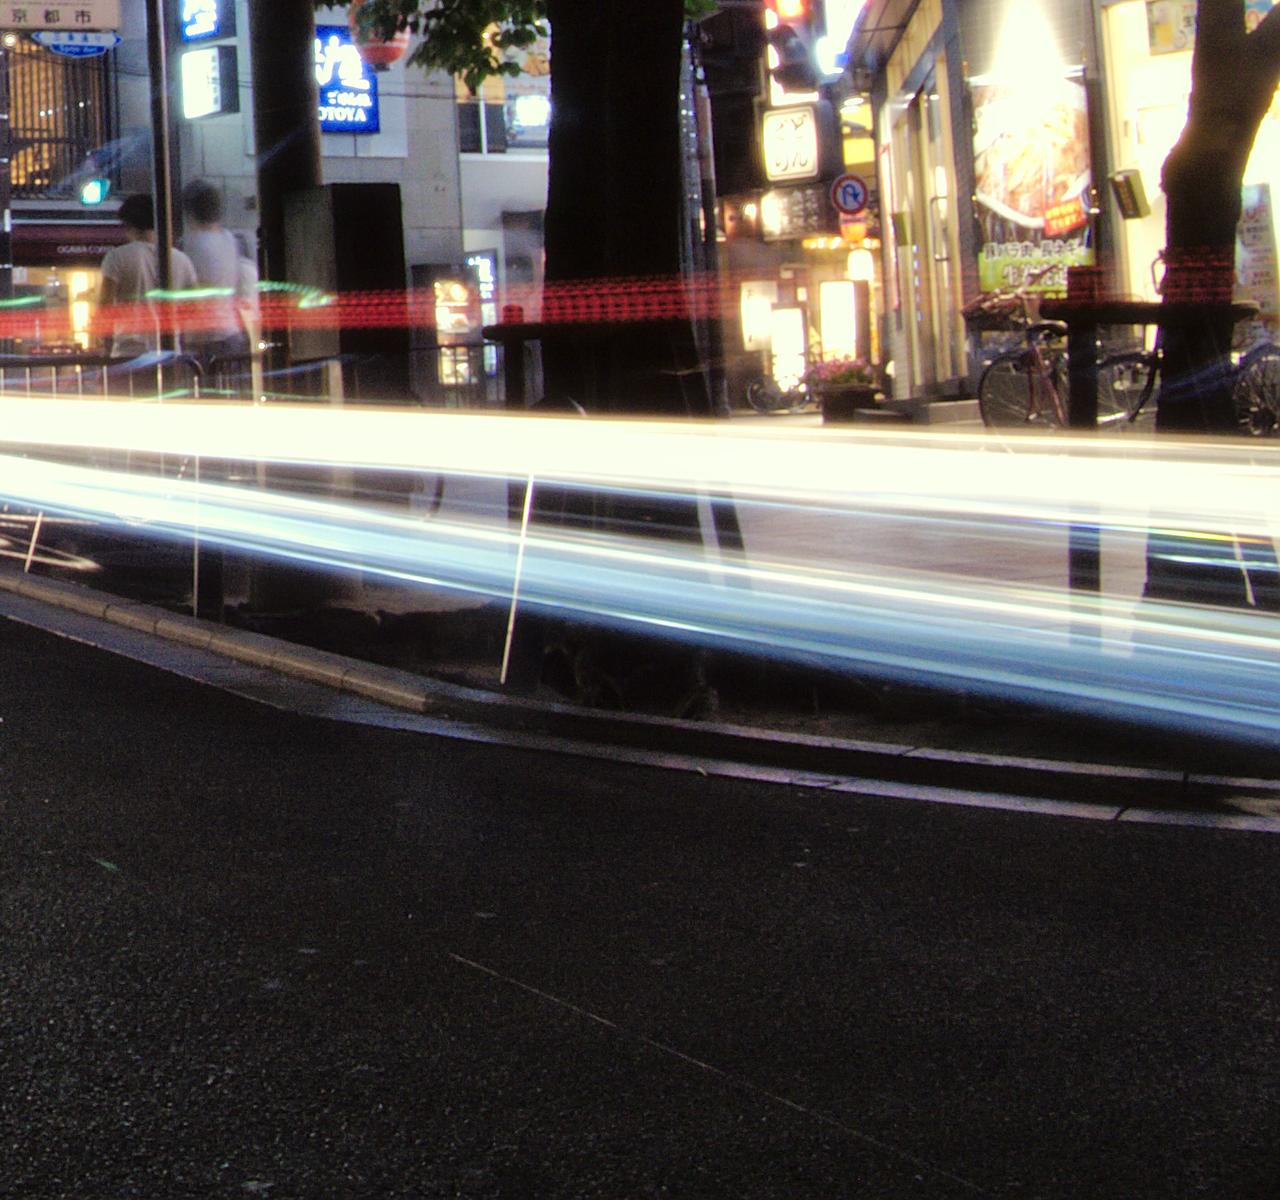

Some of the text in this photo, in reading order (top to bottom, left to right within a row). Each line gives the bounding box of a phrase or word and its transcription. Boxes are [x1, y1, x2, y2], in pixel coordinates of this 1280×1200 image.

[12, 8, 91, 24] 京都市
[318, 106, 367, 121] OTOYA
